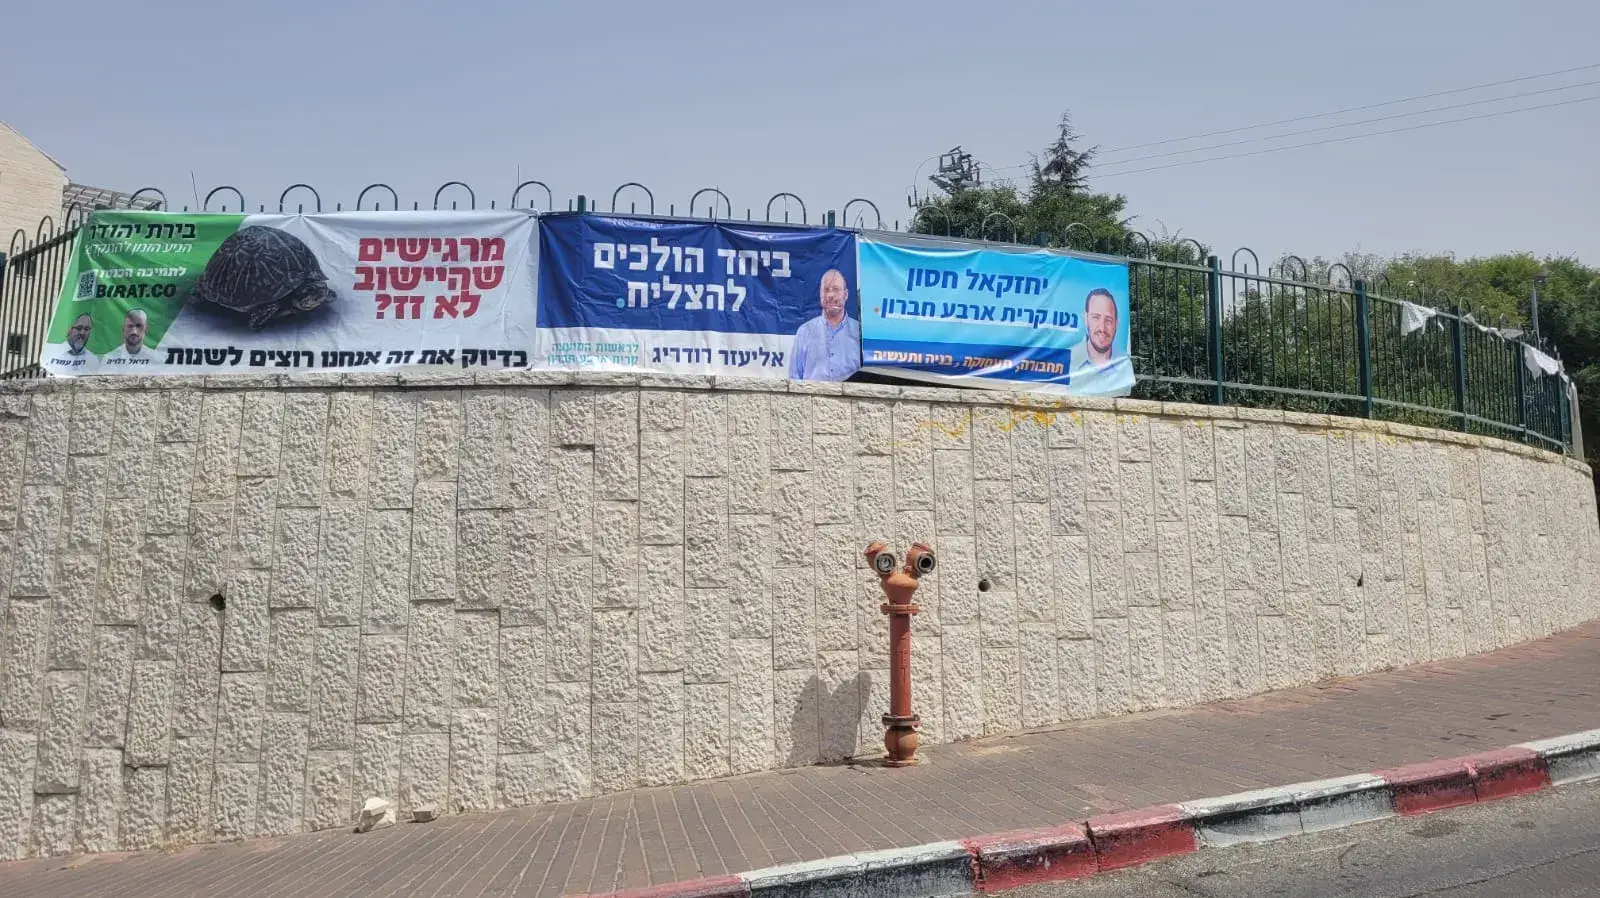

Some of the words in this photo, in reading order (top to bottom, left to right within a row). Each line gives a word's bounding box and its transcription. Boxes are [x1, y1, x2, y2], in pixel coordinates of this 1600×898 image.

[144, 223, 196, 239] בירת
[131, 243, 162, 255] הזמן
[162, 243, 193, 253] הגיע
[358, 237, 506, 263] מרגישים
[593, 237, 704, 273] הולכים
[136, 266, 187, 278] לתמיכה
[717, 248, 792, 278] ביחד
[352, 265, 505, 291] שהיישוב
[907, 268, 959, 291] חסון
[966, 268, 1048, 298] יחזקאל
[96, 283, 177, 298] BIRAT.CO
[375, 293, 425, 320] זז?
[433, 289, 481, 319] לא
[940, 304, 996, 322] ארבע
[1000, 306, 1047, 329] קרית
[1052, 311, 1078, 329] נטו
[164, 346, 244, 366] לשנות
[552, 342, 592, 353] המועצה
[596, 342, 640, 353] לראשות
[652, 347, 712, 364] רודריג
[718, 346, 784, 367] אליעזר
[249, 350, 315, 368] רוצים
[321, 350, 381, 367] אנחנו
[385, 350, 415, 365] זה
[417, 349, 455, 365] את
[461, 349, 528, 369] בדיוק
[612, 354, 639, 367] קרית
[872, 350, 922, 365] ותעשיה
[925, 352, 953, 366] בניה
